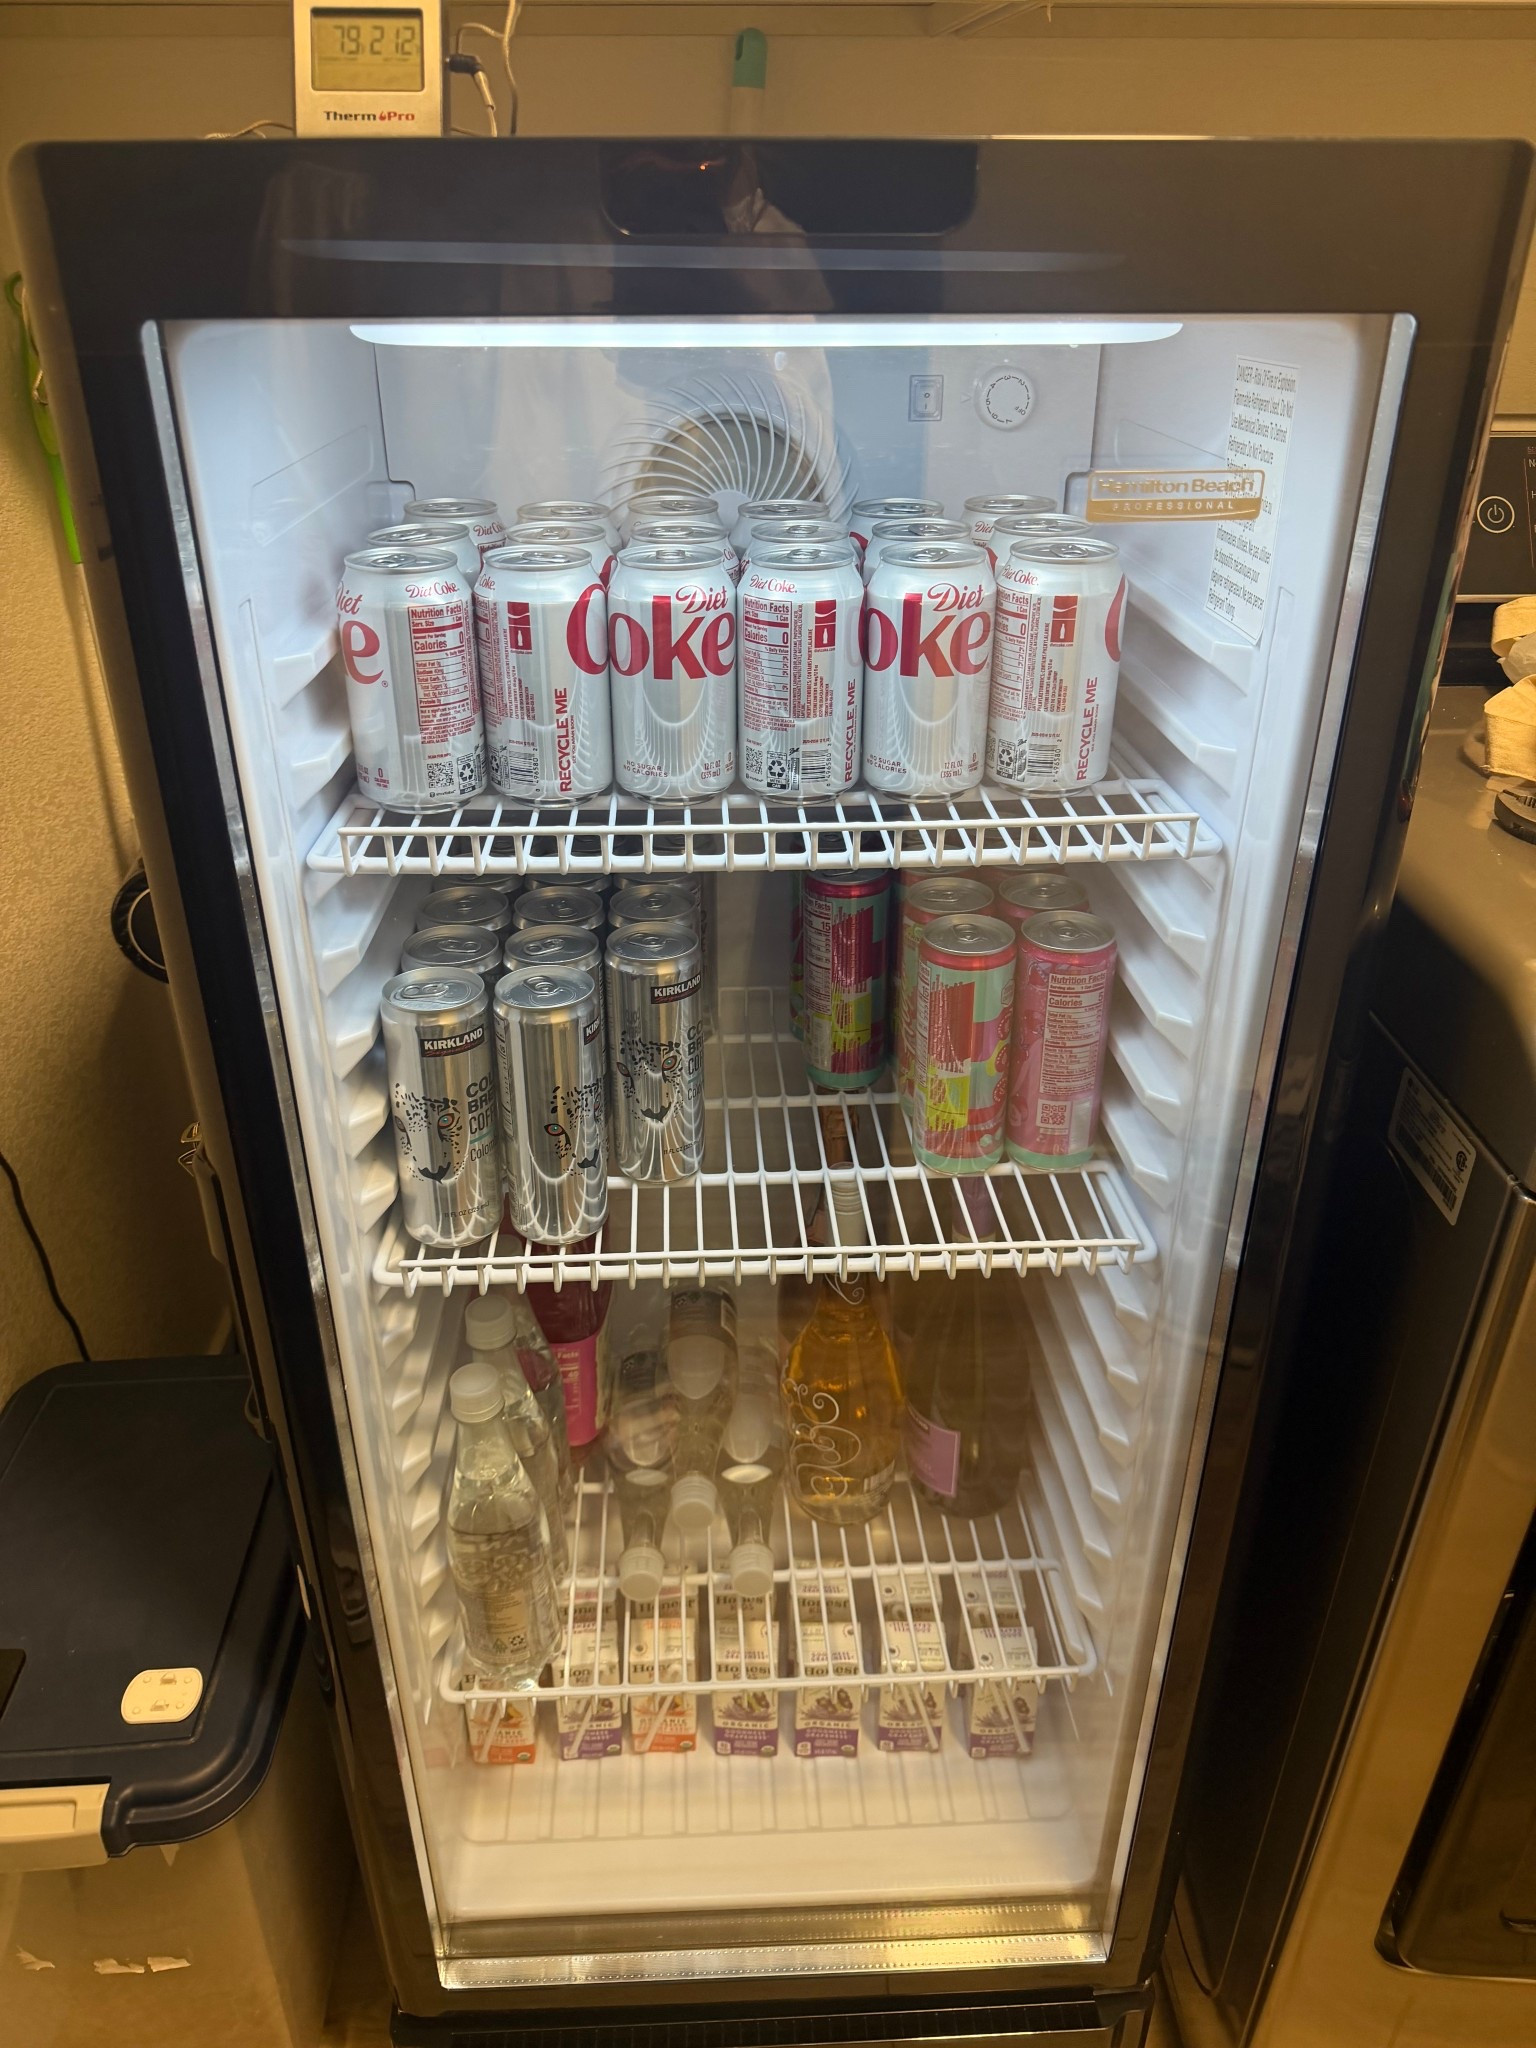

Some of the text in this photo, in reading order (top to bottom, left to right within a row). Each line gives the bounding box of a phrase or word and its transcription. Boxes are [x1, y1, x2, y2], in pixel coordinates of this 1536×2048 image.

[1099, 478, 1254, 494] Hamilton Beach
[1112, 502, 1234, 511] PROFESSIONAL
[768, 578, 796, 593] Coke
[1013, 569, 1037, 586] Coke
[405, 581, 459, 598] Diet Coke
[927, 583, 984, 612] Diet
[675, 584, 728, 614] Diet
[744, 597, 789, 613] Nutrition Facts
[1012, 593, 1029, 606] Facts
[411, 604, 462, 619] Nutrition Facts
[608, 594, 735, 681] oke
[744, 627, 789, 644] Calories 0
[866, 592, 990, 679] oke
[1020, 622, 1027, 636] 0
[414, 640, 447, 651] Calories
[847, 679, 856, 705] ME
[1085, 677, 1098, 704] ME
[555, 687, 568, 715] ME
[845, 707, 855, 782] RECYCLE
[1076, 706, 1094, 781] RECYCLE
[556, 718, 573, 792] RECYCLE
[878, 757, 901, 767] SUGAR
[632, 767, 668, 778] CALORIES
[874, 762, 907, 774] CALORIES
[820, 920, 831, 931] 15
[654, 975, 700, 997] KIRKLAND
[1050, 974, 1087, 985] Nutrition
[1049, 997, 1083, 1007] Calories
[424, 1027, 483, 1050] KIRKLAND
[466, 1072, 494, 1098] COL
[468, 1089, 497, 1115] BRE
[469, 1105, 497, 1135] COFF
[722, 1720, 769, 1728] ORGANIC
[804, 1720, 851, 1728] ORGANIC
